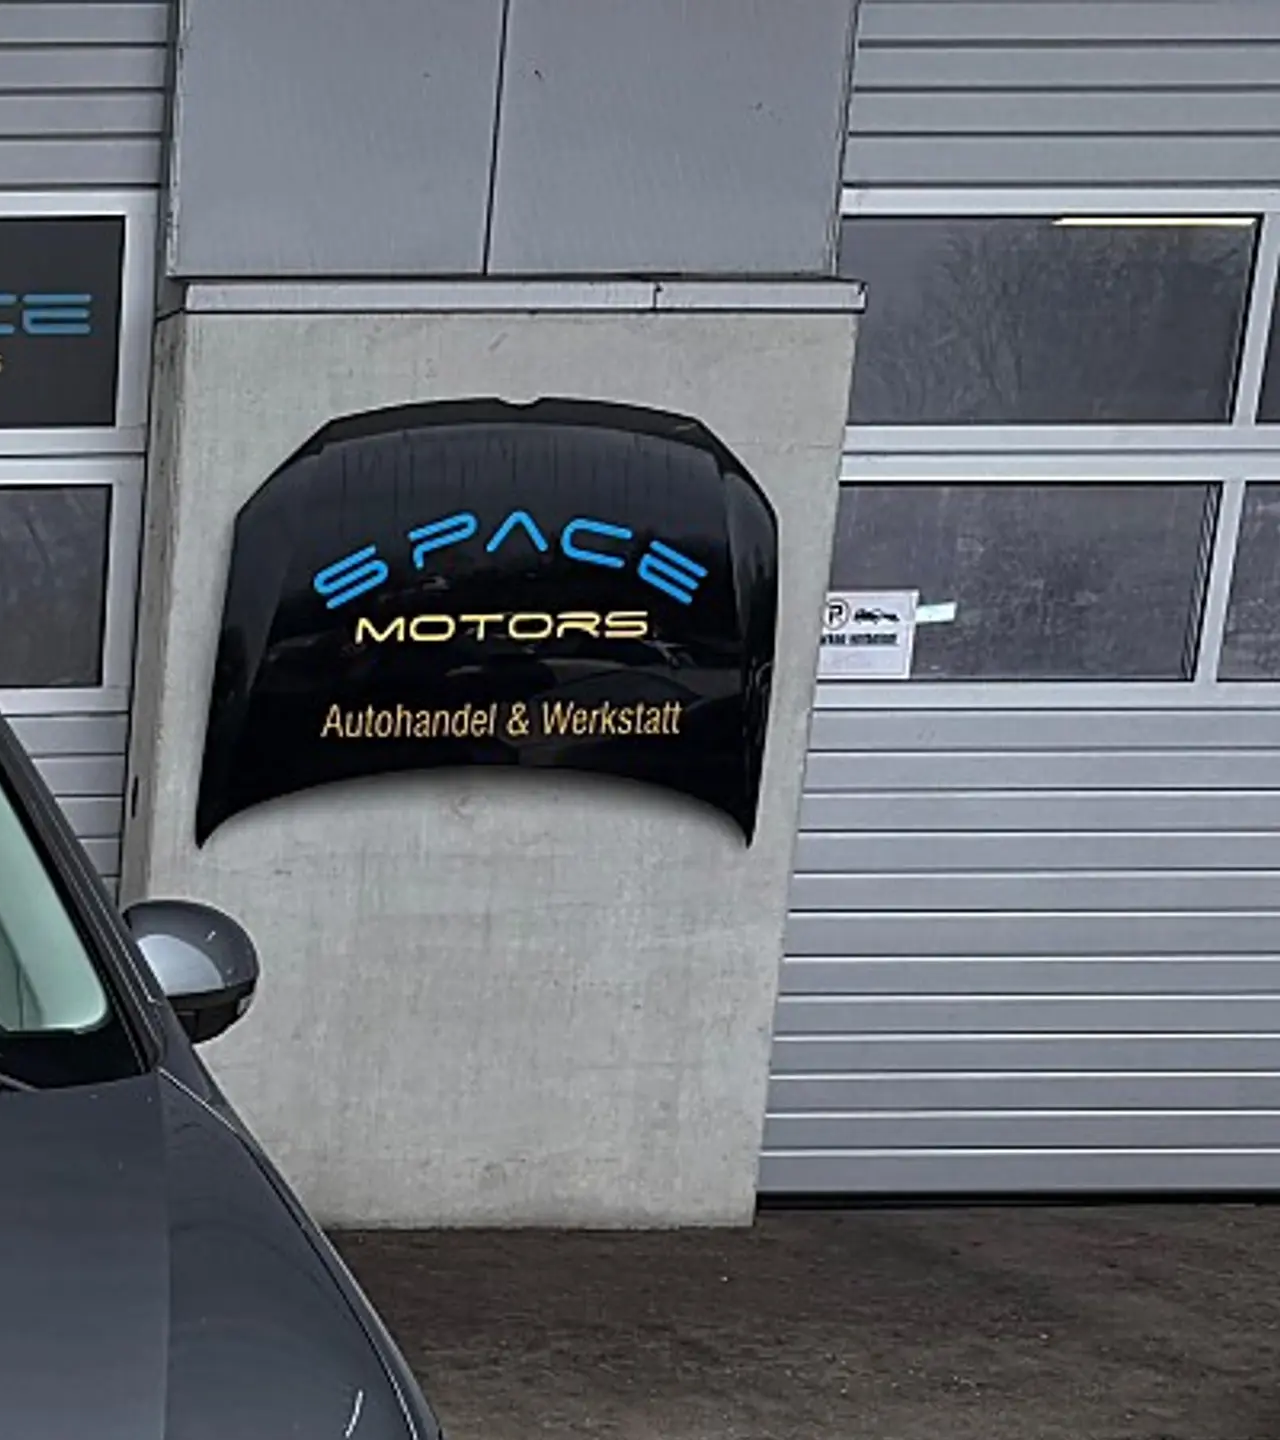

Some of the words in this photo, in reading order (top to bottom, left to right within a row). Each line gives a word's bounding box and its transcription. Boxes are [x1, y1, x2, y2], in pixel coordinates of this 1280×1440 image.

[312, 508, 708, 610] SPACE
[355, 611, 649, 642] MOTORS
[320, 702, 494, 740] Autohandel
[506, 702, 529, 738] &
[543, 702, 683, 738] Werkstatt
